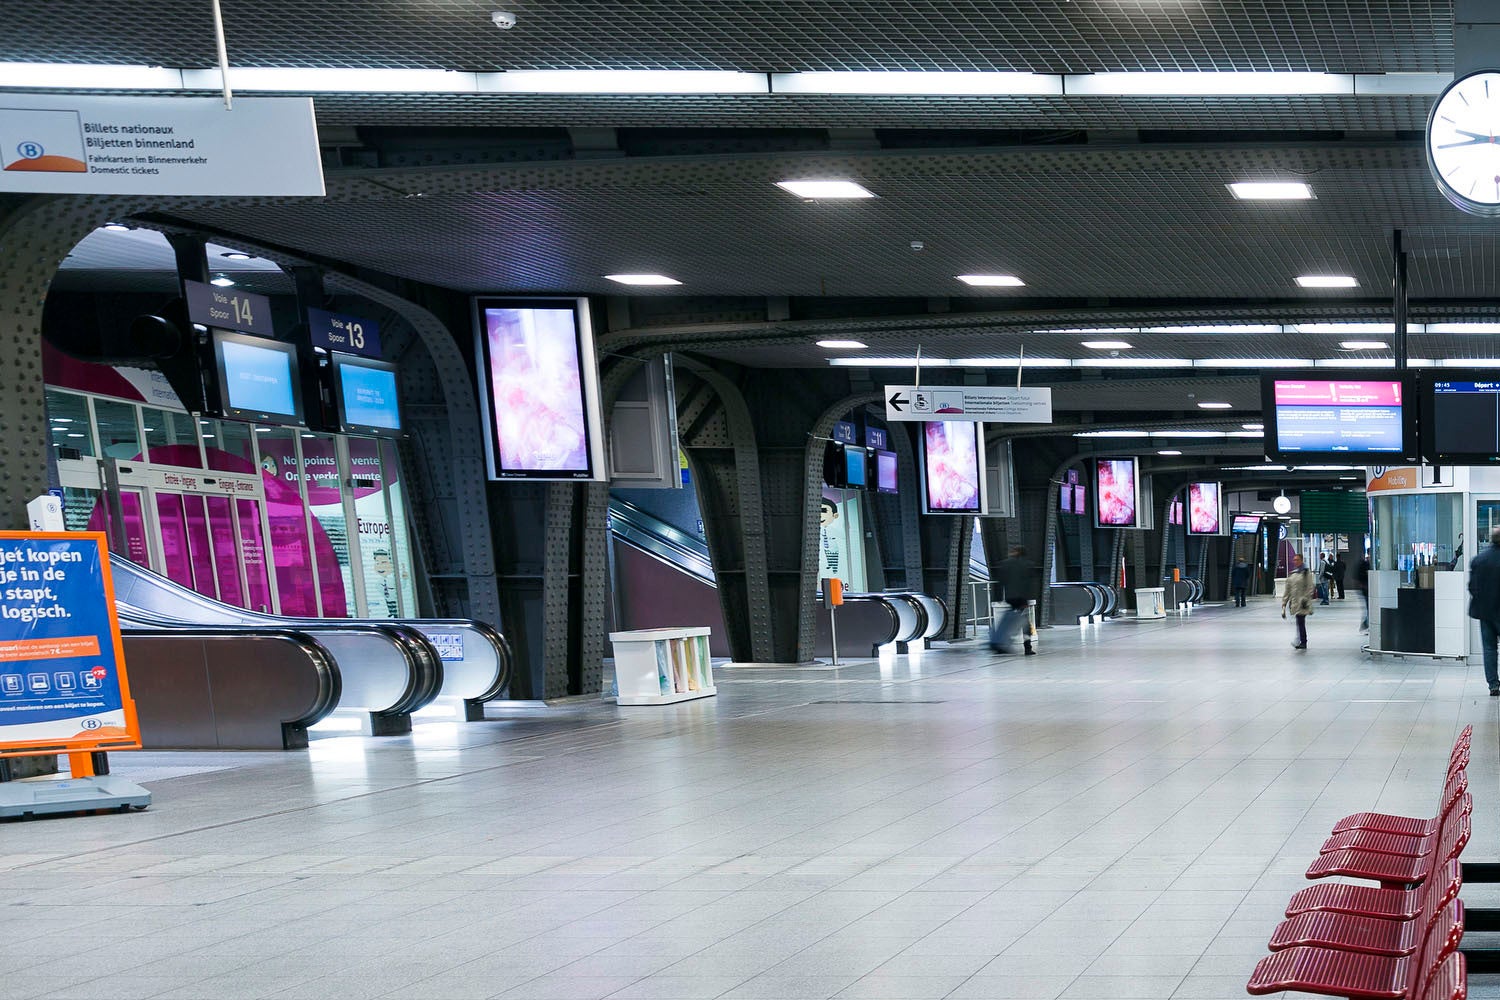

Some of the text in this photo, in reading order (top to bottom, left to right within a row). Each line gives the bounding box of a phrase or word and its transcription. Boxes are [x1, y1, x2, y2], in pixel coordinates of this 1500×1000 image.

[84, 123, 173, 134] Billets nationaux
[86, 137, 194, 149] Biljetten binnenland
[89, 155, 134, 163] Fahrkarten
[148, 156, 207, 164] Binnenverkehr
[91, 166, 159, 175] Domestic tickets
[213, 292, 228, 304] Voie
[210, 307, 229, 320] Spoor
[230, 297, 253, 326] 14
[331, 318, 344, 329] Voie
[328, 332, 345, 343] Spoor
[345, 322, 365, 349] 13
[1474, 381, 1494, 389] Départ
[844, 425, 851, 441] 12
[304, 456, 336, 468] points
[352, 458, 380, 466] vente
[1387, 475, 1408, 488] Mobility
[357, 518, 390, 539] Europe
[26, 548, 83, 566] kopen
[20, 566, 40, 581] in
[43, 566, 66, 581] de
[5, 586, 58, 603] stapt,
[1, 603, 72, 623] logisch.
